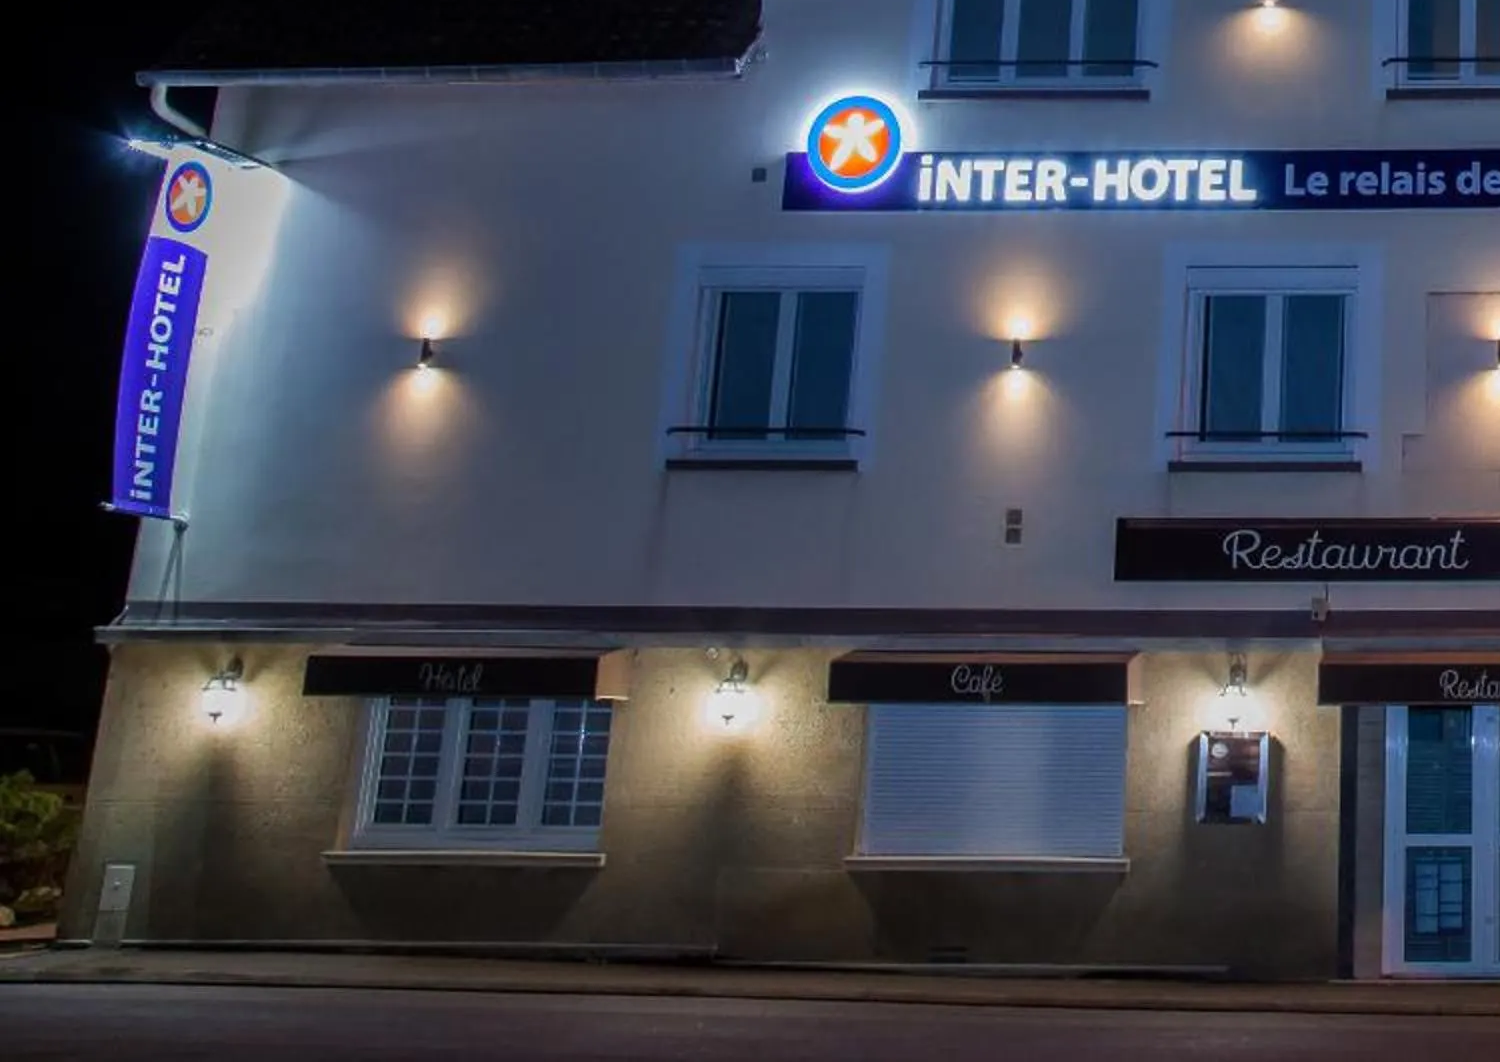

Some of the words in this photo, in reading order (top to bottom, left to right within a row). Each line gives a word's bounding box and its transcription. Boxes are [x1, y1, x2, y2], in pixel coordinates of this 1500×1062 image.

[1285, 163, 1329, 196] Le
[1340, 162, 1446, 196] relais
[1223, 528, 1469, 571] Restaurant
